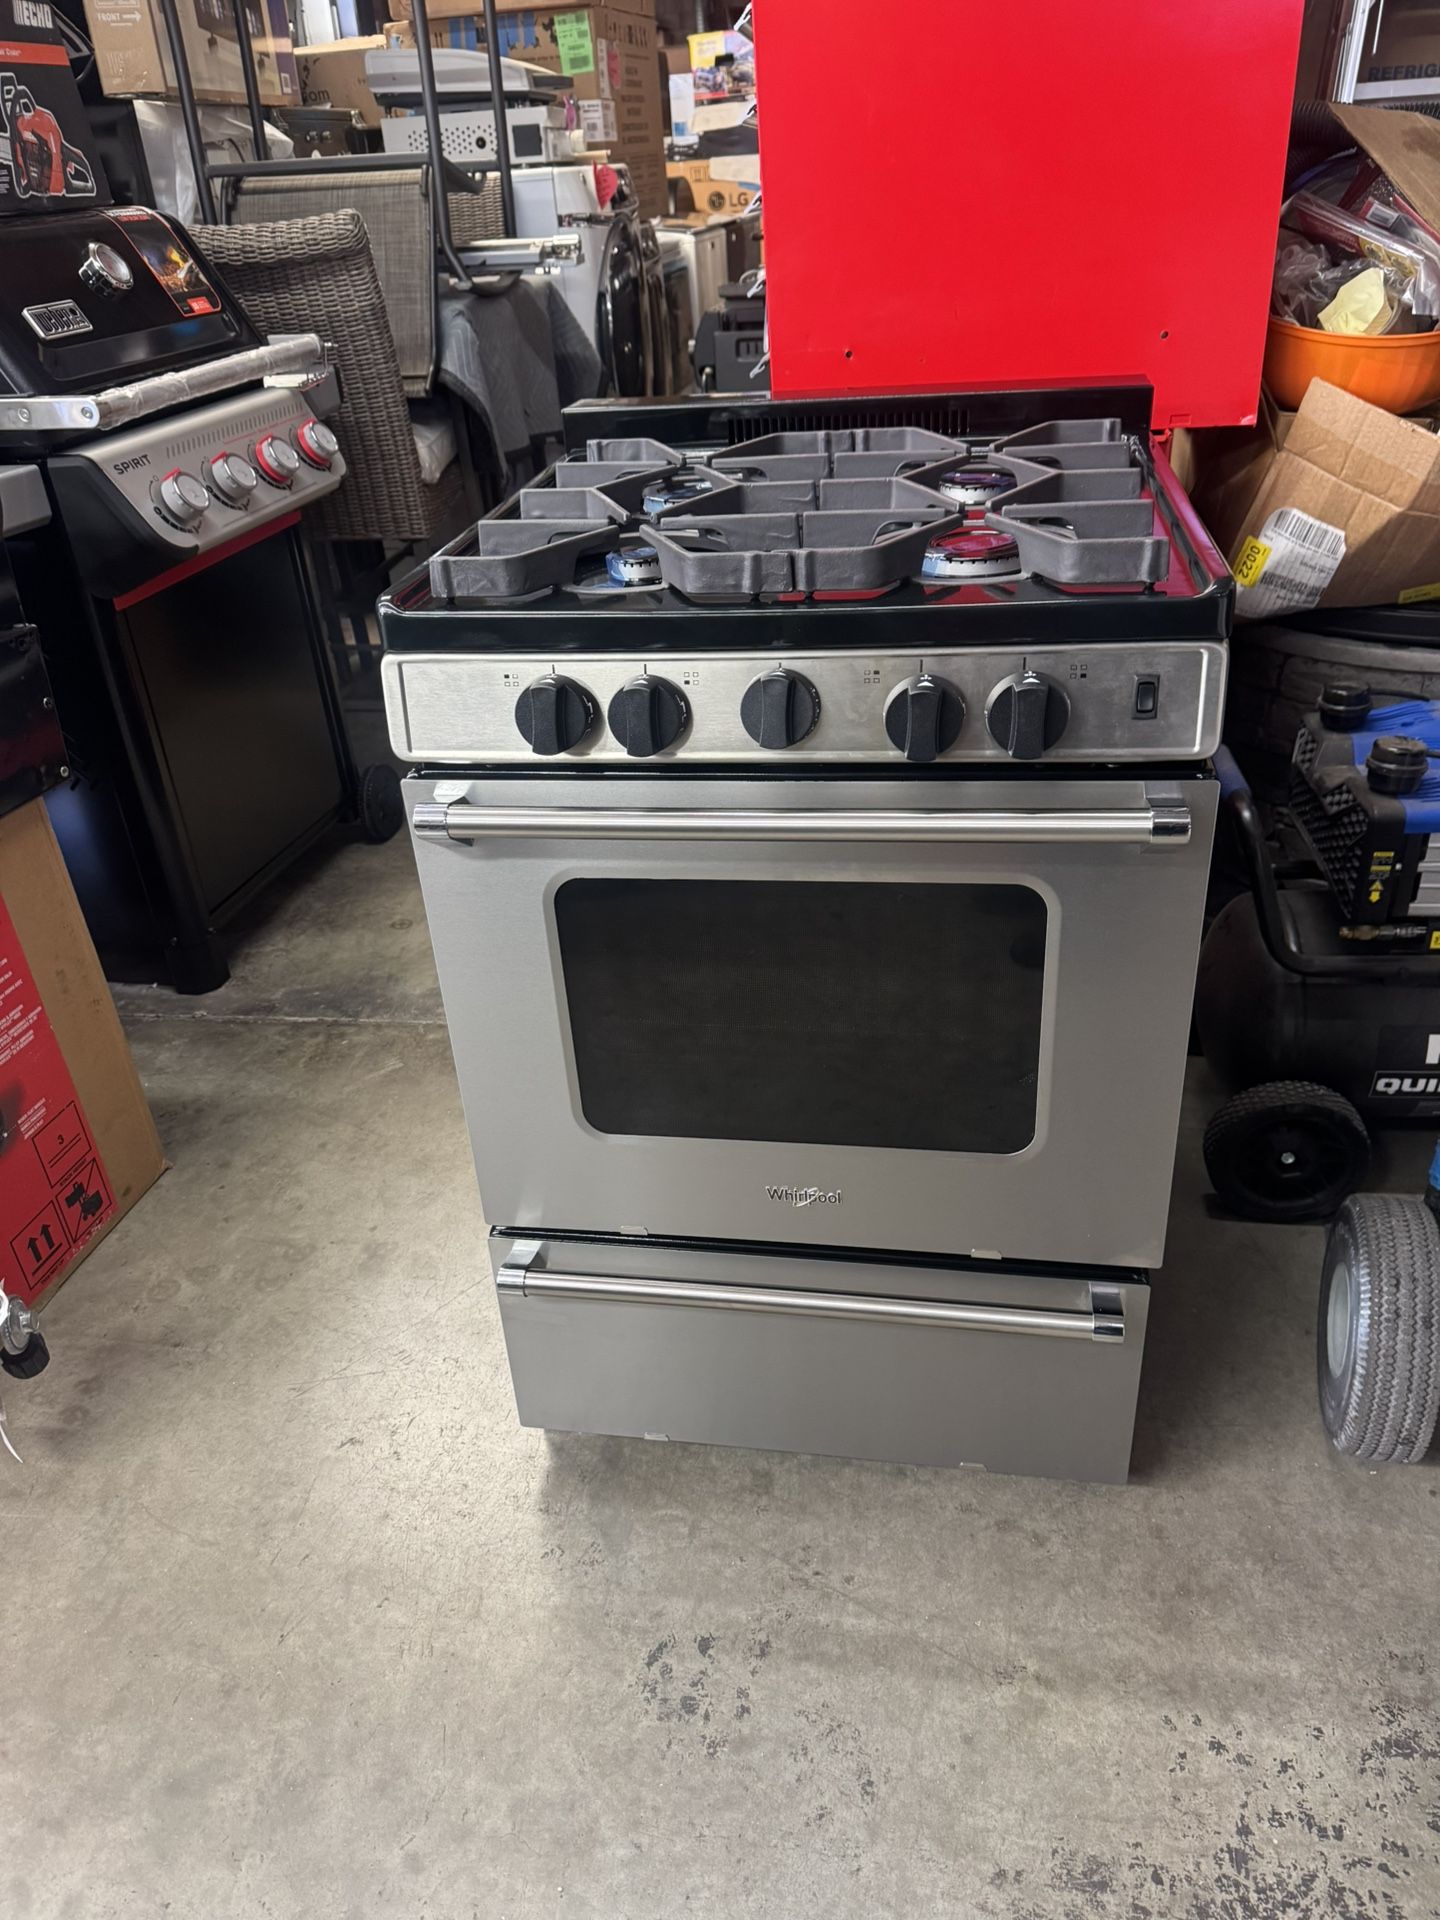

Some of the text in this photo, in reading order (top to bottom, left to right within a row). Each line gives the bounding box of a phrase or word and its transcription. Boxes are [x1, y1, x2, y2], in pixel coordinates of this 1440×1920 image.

[22, 0, 54, 29] ECHO
[97, 12, 120, 21] FRONT
[1368, 63, 1440, 82] REFRIG
[729, 191, 749, 208] LG
[113, 454, 152, 475] SPIRIT
[1239, 545, 1260, 579] 0022
[1375, 1078, 1440, 1095] QUI
[57, 1134, 65, 1145] 3
[765, 1185, 842, 1206] Whirlpool
